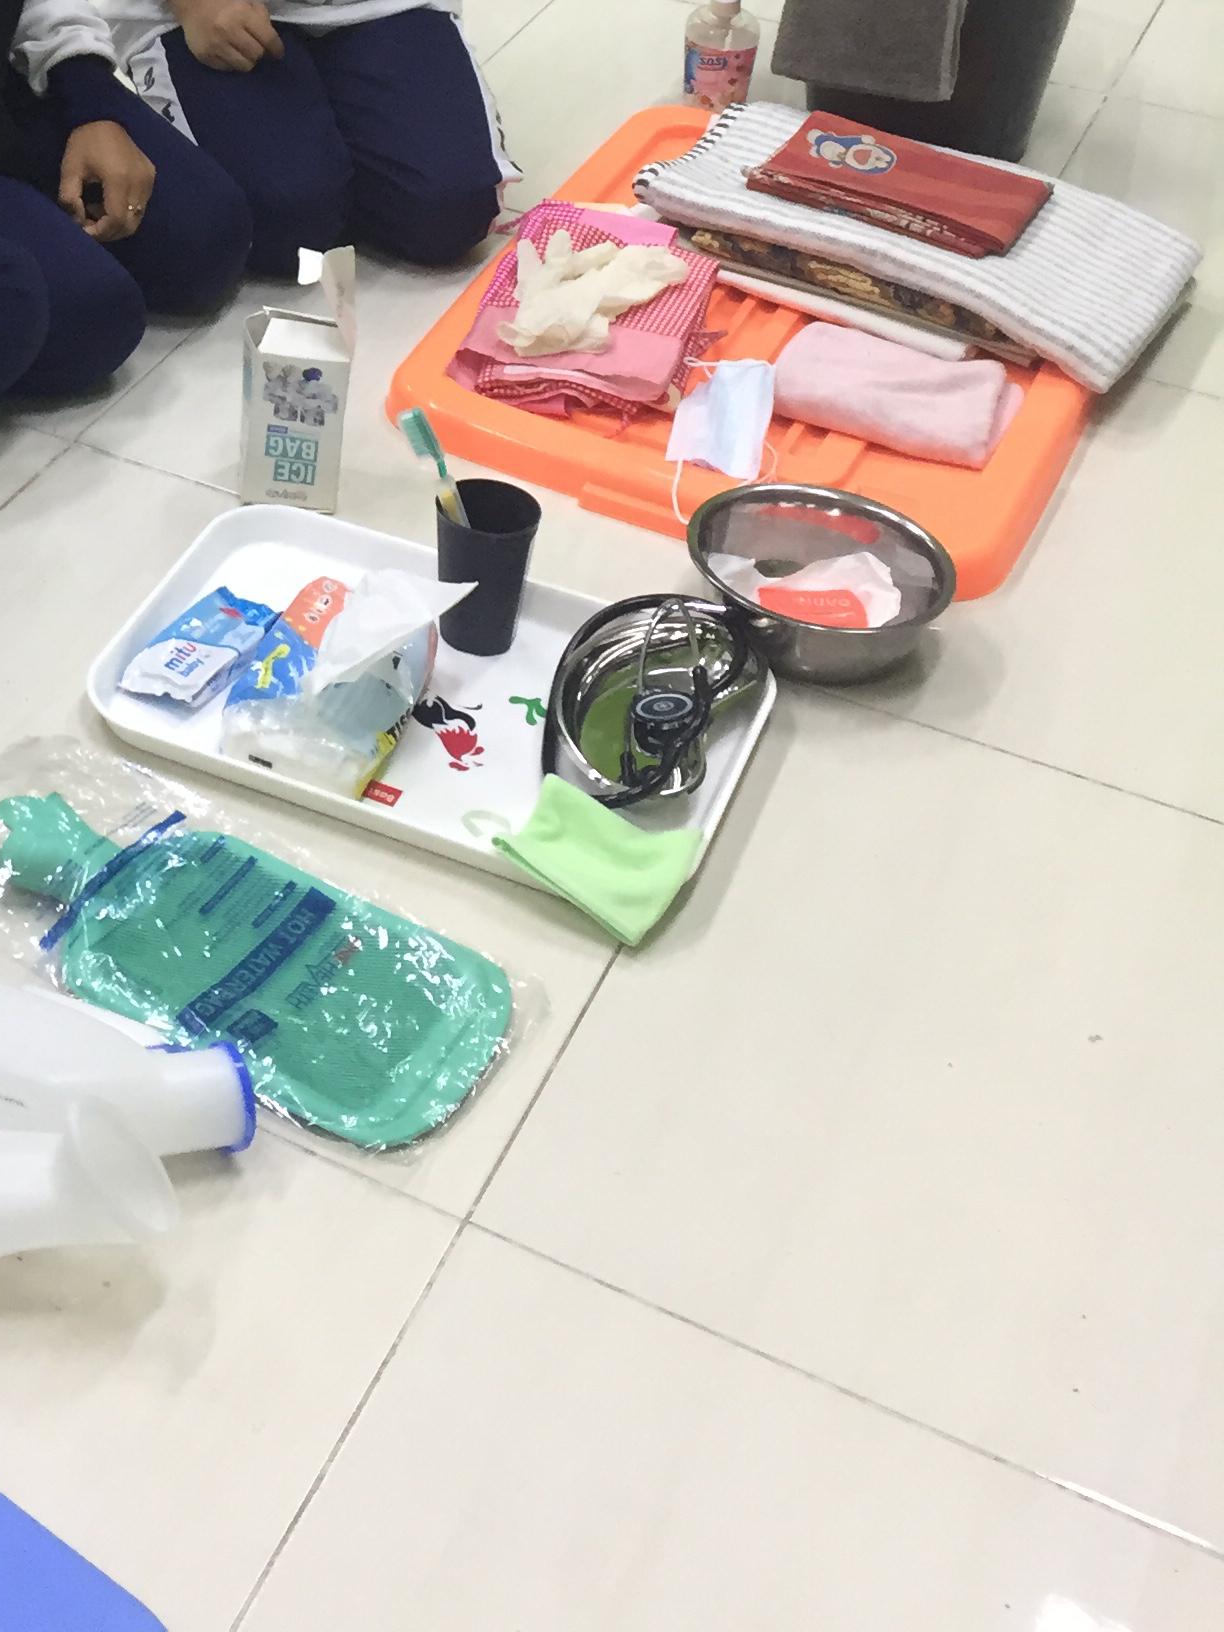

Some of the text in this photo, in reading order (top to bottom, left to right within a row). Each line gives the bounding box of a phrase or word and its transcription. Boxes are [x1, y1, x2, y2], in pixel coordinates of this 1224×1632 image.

[267, 436, 316, 459] BAG
[276, 460, 314, 483] ICE
[163, 641, 196, 672] mitu
[179, 658, 204, 678] baby
[279, 906, 316, 944] HOT
[226, 941, 283, 994] WATER
